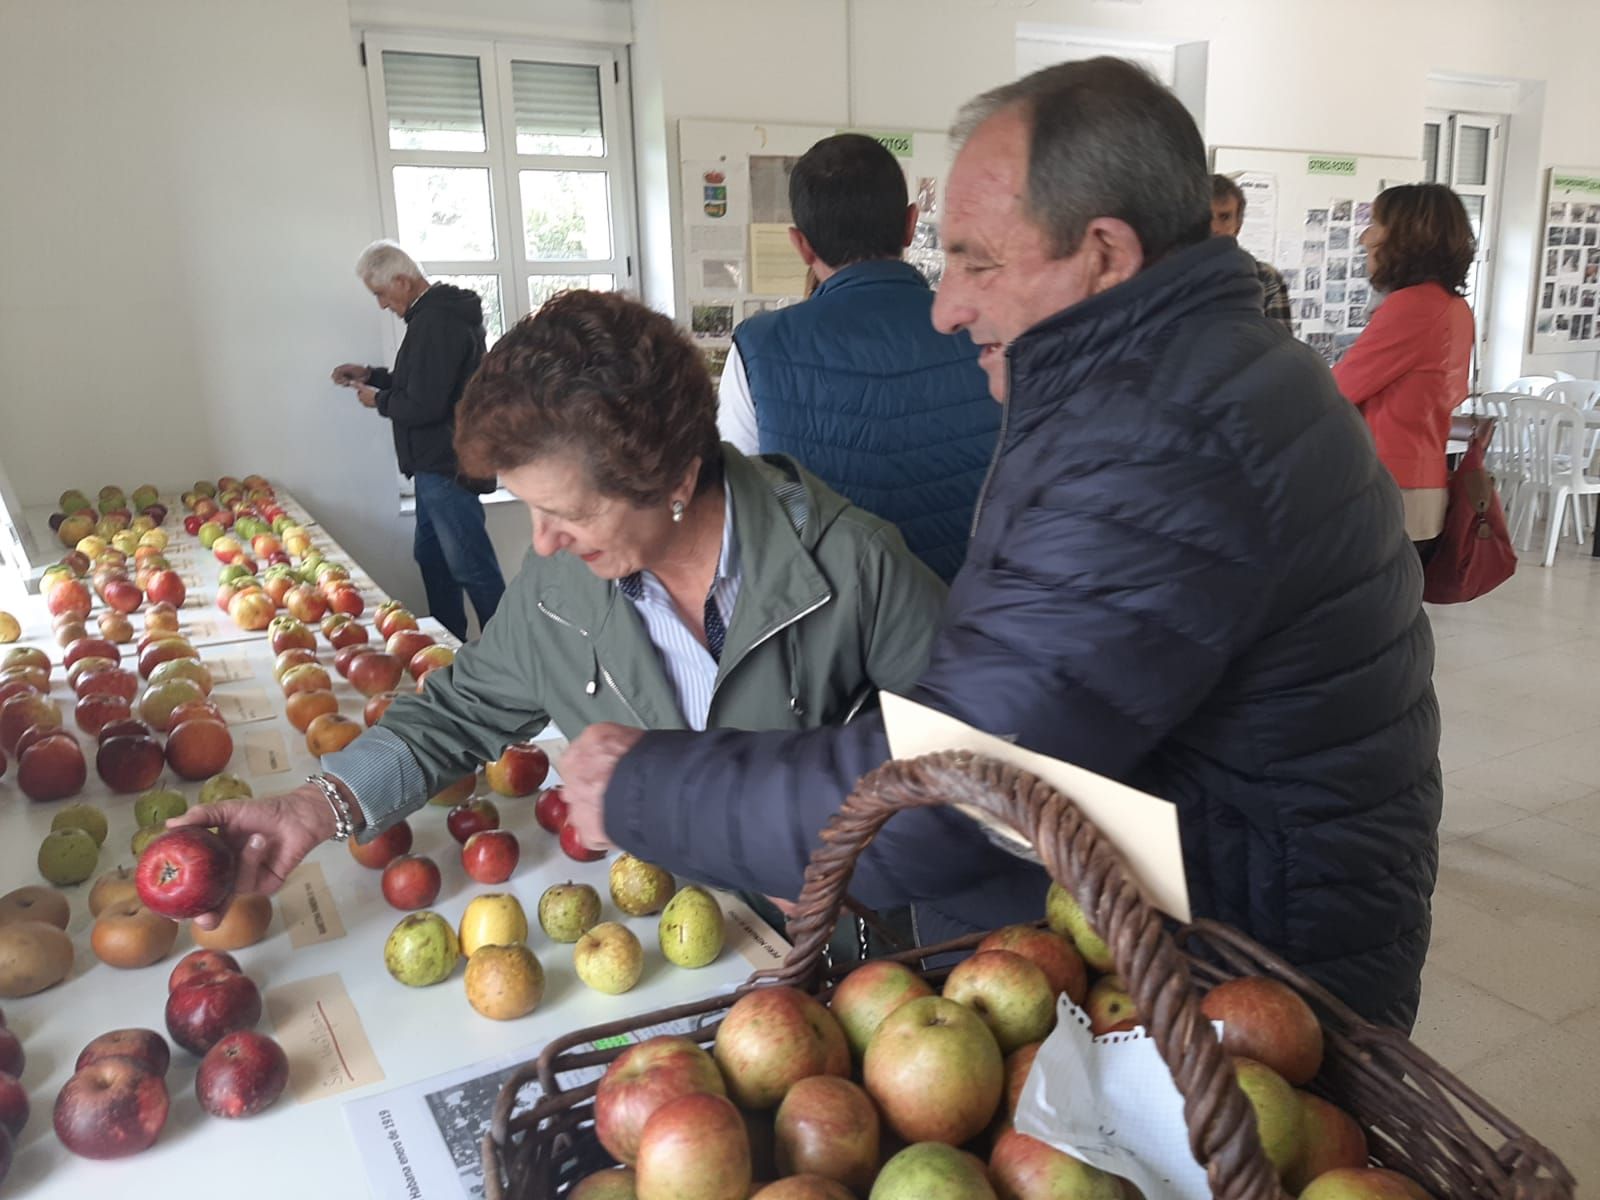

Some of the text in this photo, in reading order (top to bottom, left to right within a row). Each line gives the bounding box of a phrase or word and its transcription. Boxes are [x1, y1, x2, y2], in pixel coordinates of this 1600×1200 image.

[379, 1109, 395, 1130] 1919
[388, 1129, 399, 1141] de
[393, 1140, 408, 1165] enero
